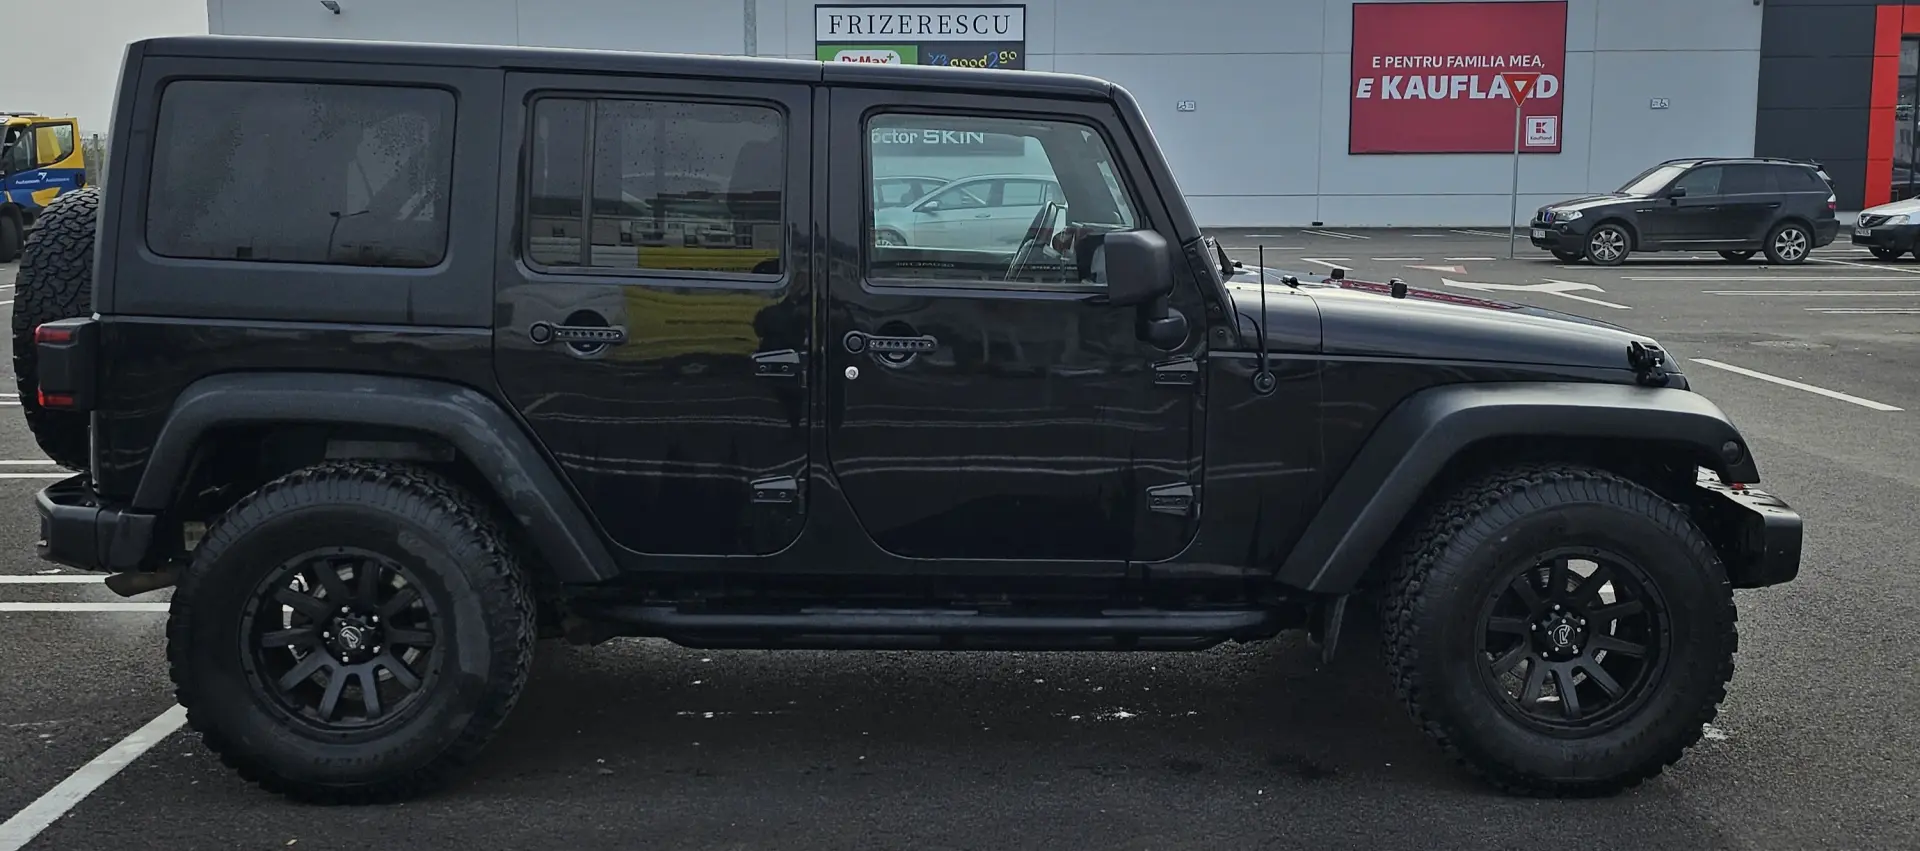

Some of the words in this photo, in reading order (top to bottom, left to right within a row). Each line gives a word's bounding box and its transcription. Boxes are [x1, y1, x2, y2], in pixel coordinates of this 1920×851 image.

[828, 14, 1011, 35] FRIZERESCU
[1372, 56, 1381, 68] E
[1385, 56, 1443, 68] PENTRU
[1446, 55, 1505, 68] FAMILIA
[1509, 55, 1546, 69] MEA,
[1356, 77, 1374, 99] E
[1381, 73, 1559, 99] KAUFLAD
